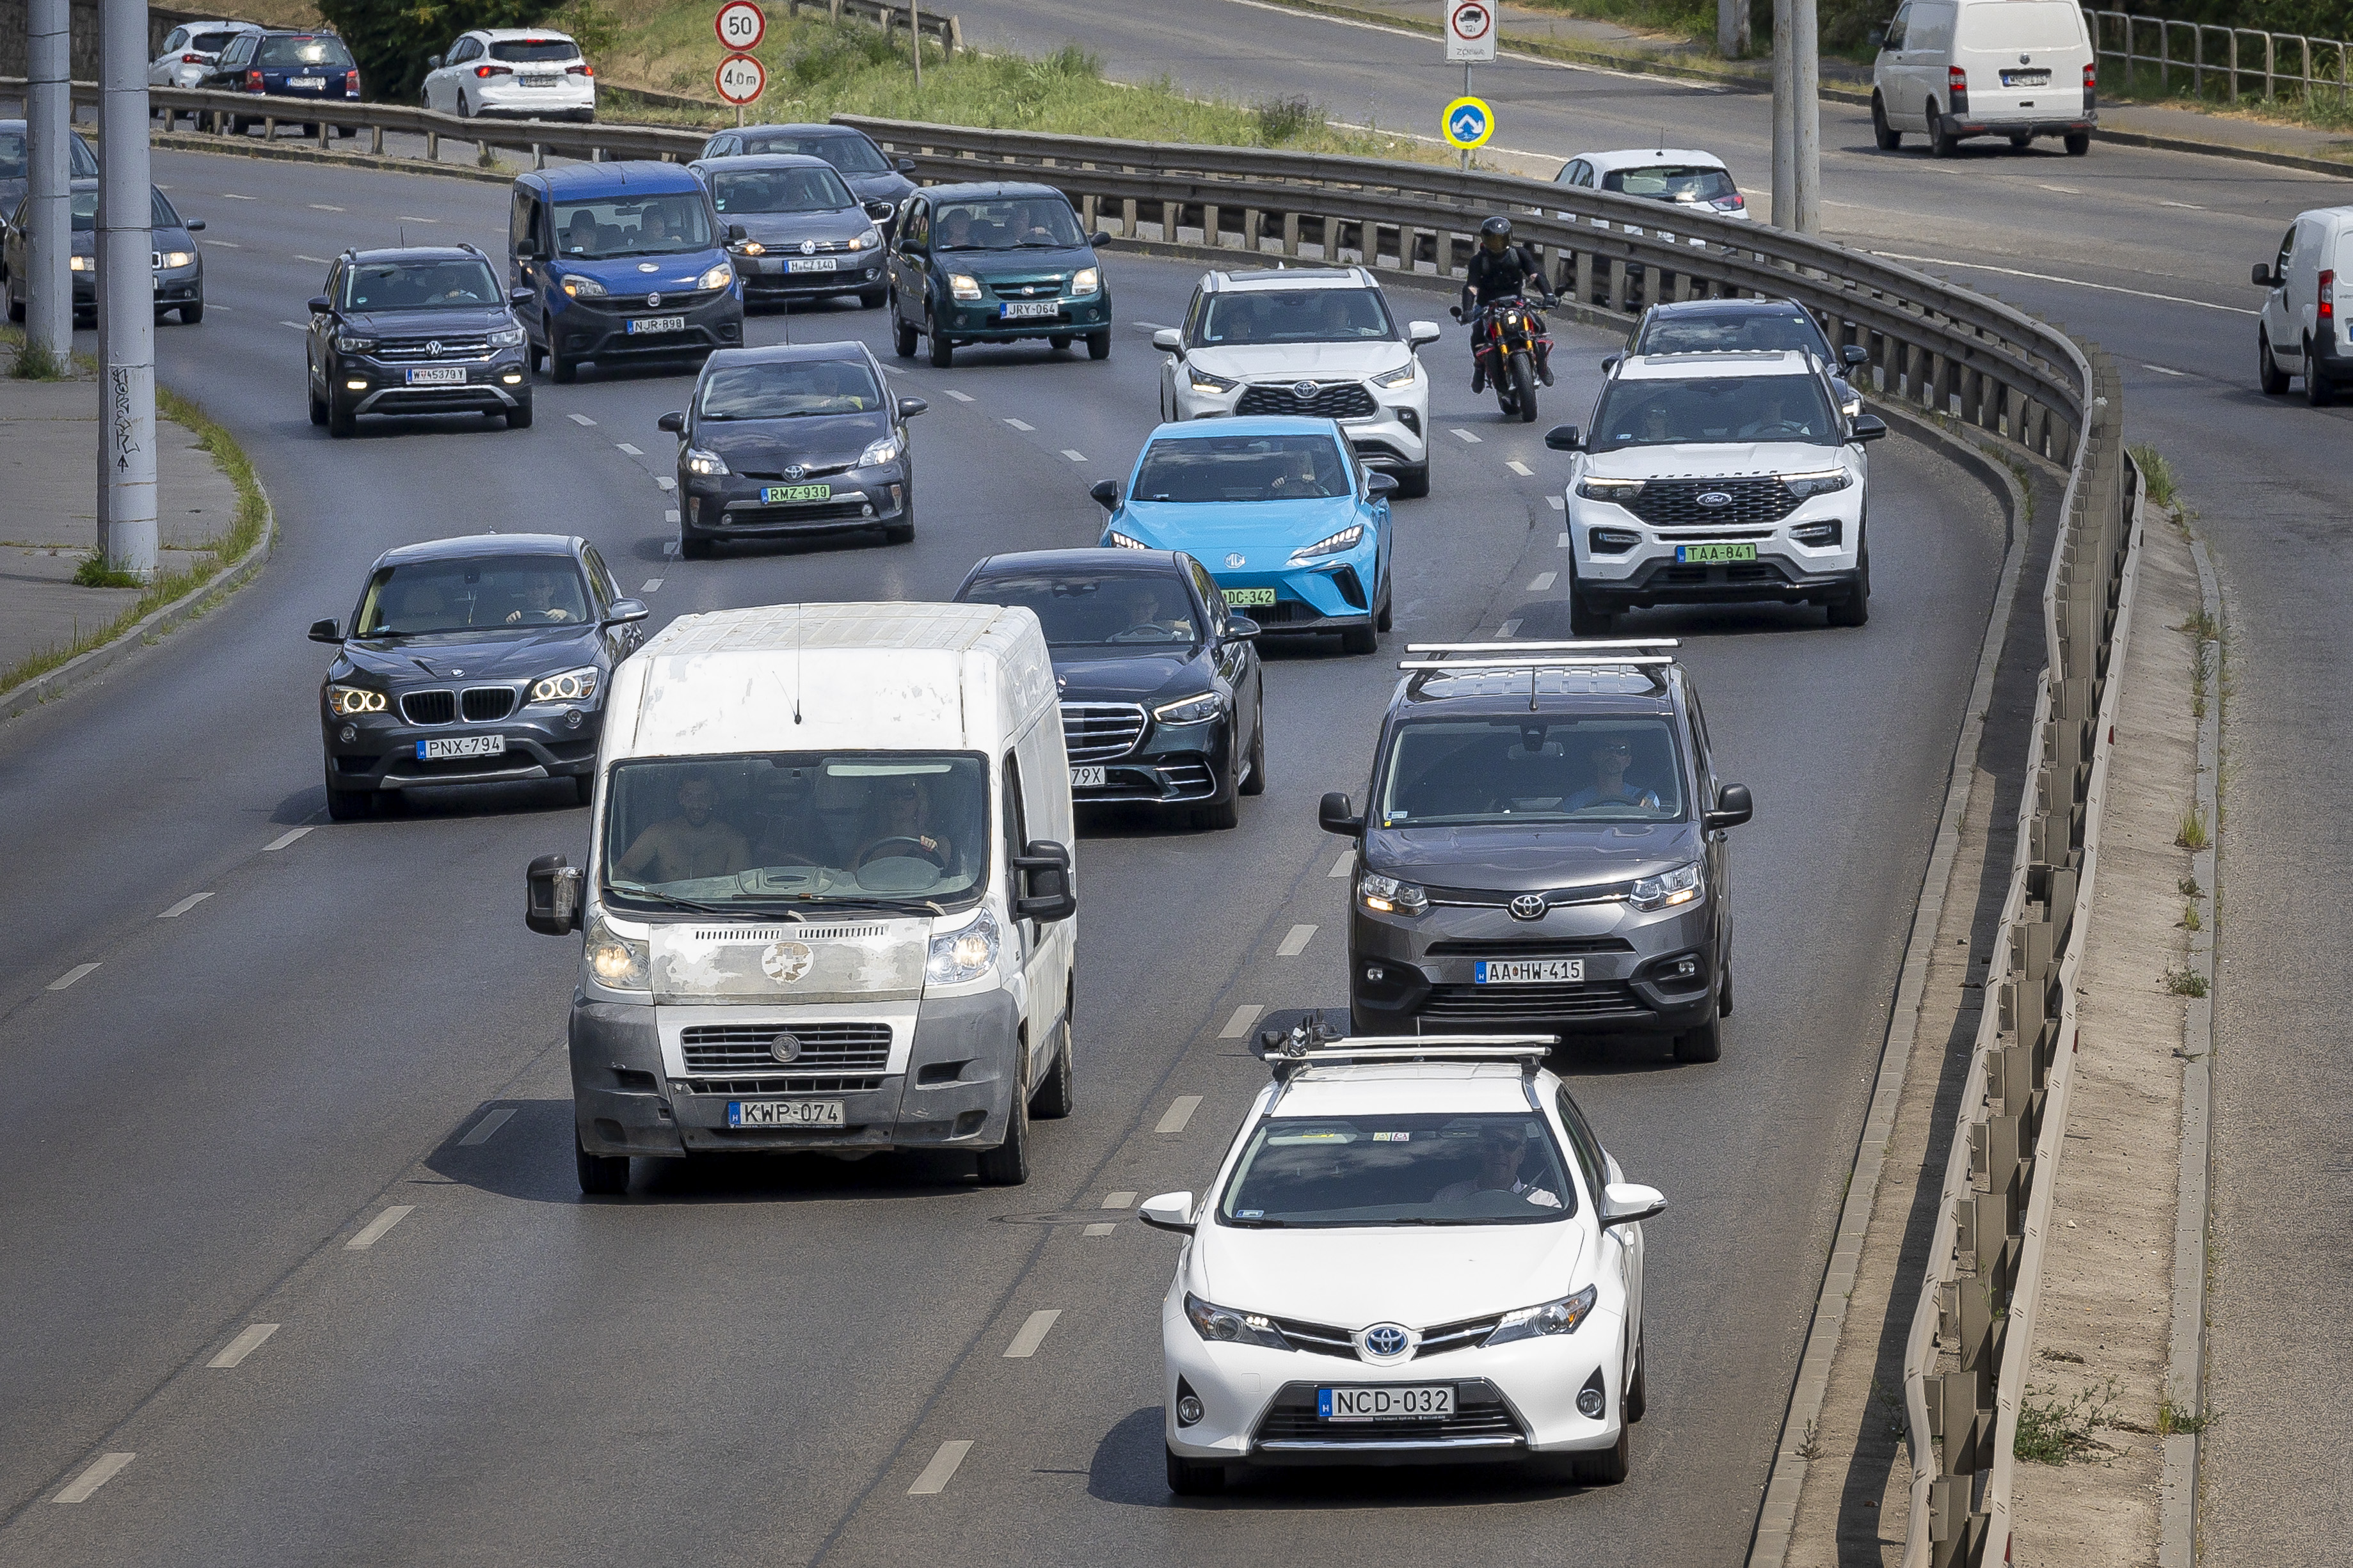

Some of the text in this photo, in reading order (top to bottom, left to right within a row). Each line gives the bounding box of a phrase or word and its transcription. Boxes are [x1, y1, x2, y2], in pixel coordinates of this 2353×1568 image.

[729, 17, 751, 35] 50
[1009, 304, 1055, 315] JRY-064
[770, 487, 827, 500] RMZ-939
[1225, 553, 1245, 567] MG
[1688, 546, 1751, 560] TAA-841
[429, 737, 499, 756] PNX-794
[745, 1104, 838, 1122] KWP-074
[1337, 1390, 1448, 1414] NCD-032
